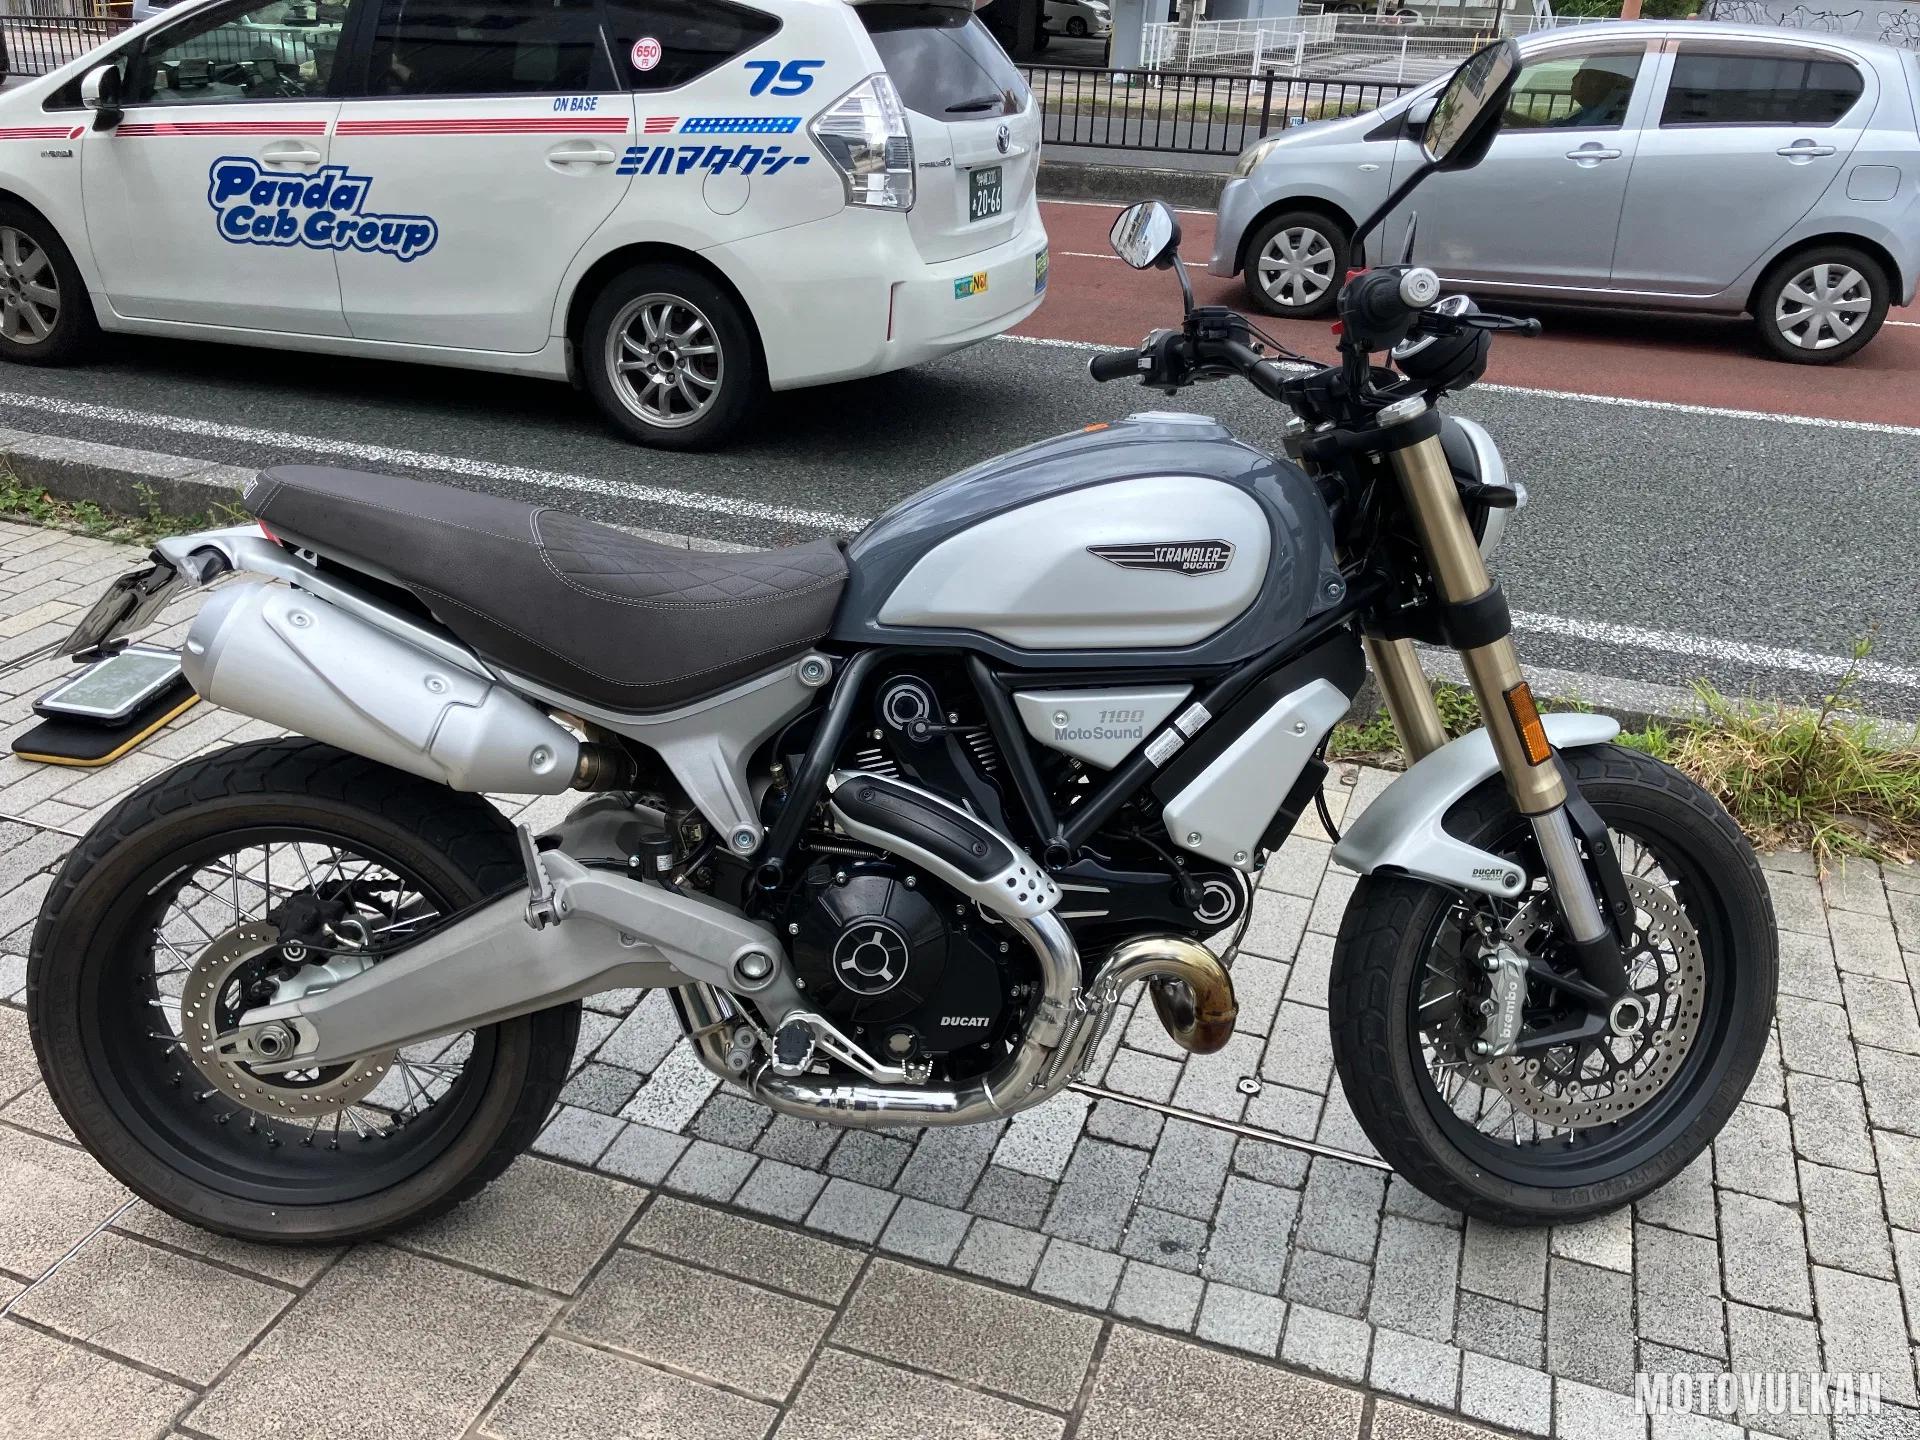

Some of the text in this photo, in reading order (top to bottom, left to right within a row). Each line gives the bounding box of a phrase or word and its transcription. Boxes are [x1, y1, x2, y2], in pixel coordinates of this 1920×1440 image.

[636, 45, 657, 57] 650
[642, 58, 649, 67] 円
[743, 60, 826, 97] 75
[553, 96, 598, 112] ON BASE
[616, 144, 811, 176] ミハマタクシー
[215, 165, 361, 211] Panda
[977, 187, 1002, 217] 20-66
[223, 205, 431, 254] Cab Group
[1154, 547, 1222, 562] SCRAMBLER
[1182, 561, 1217, 570] DUCATI
[1098, 709, 1145, 724] 1100
[1054, 725, 1143, 741] MotoSound
[1500, 981, 1518, 1038] brembo
[940, 1016, 990, 1027] DUCATI
